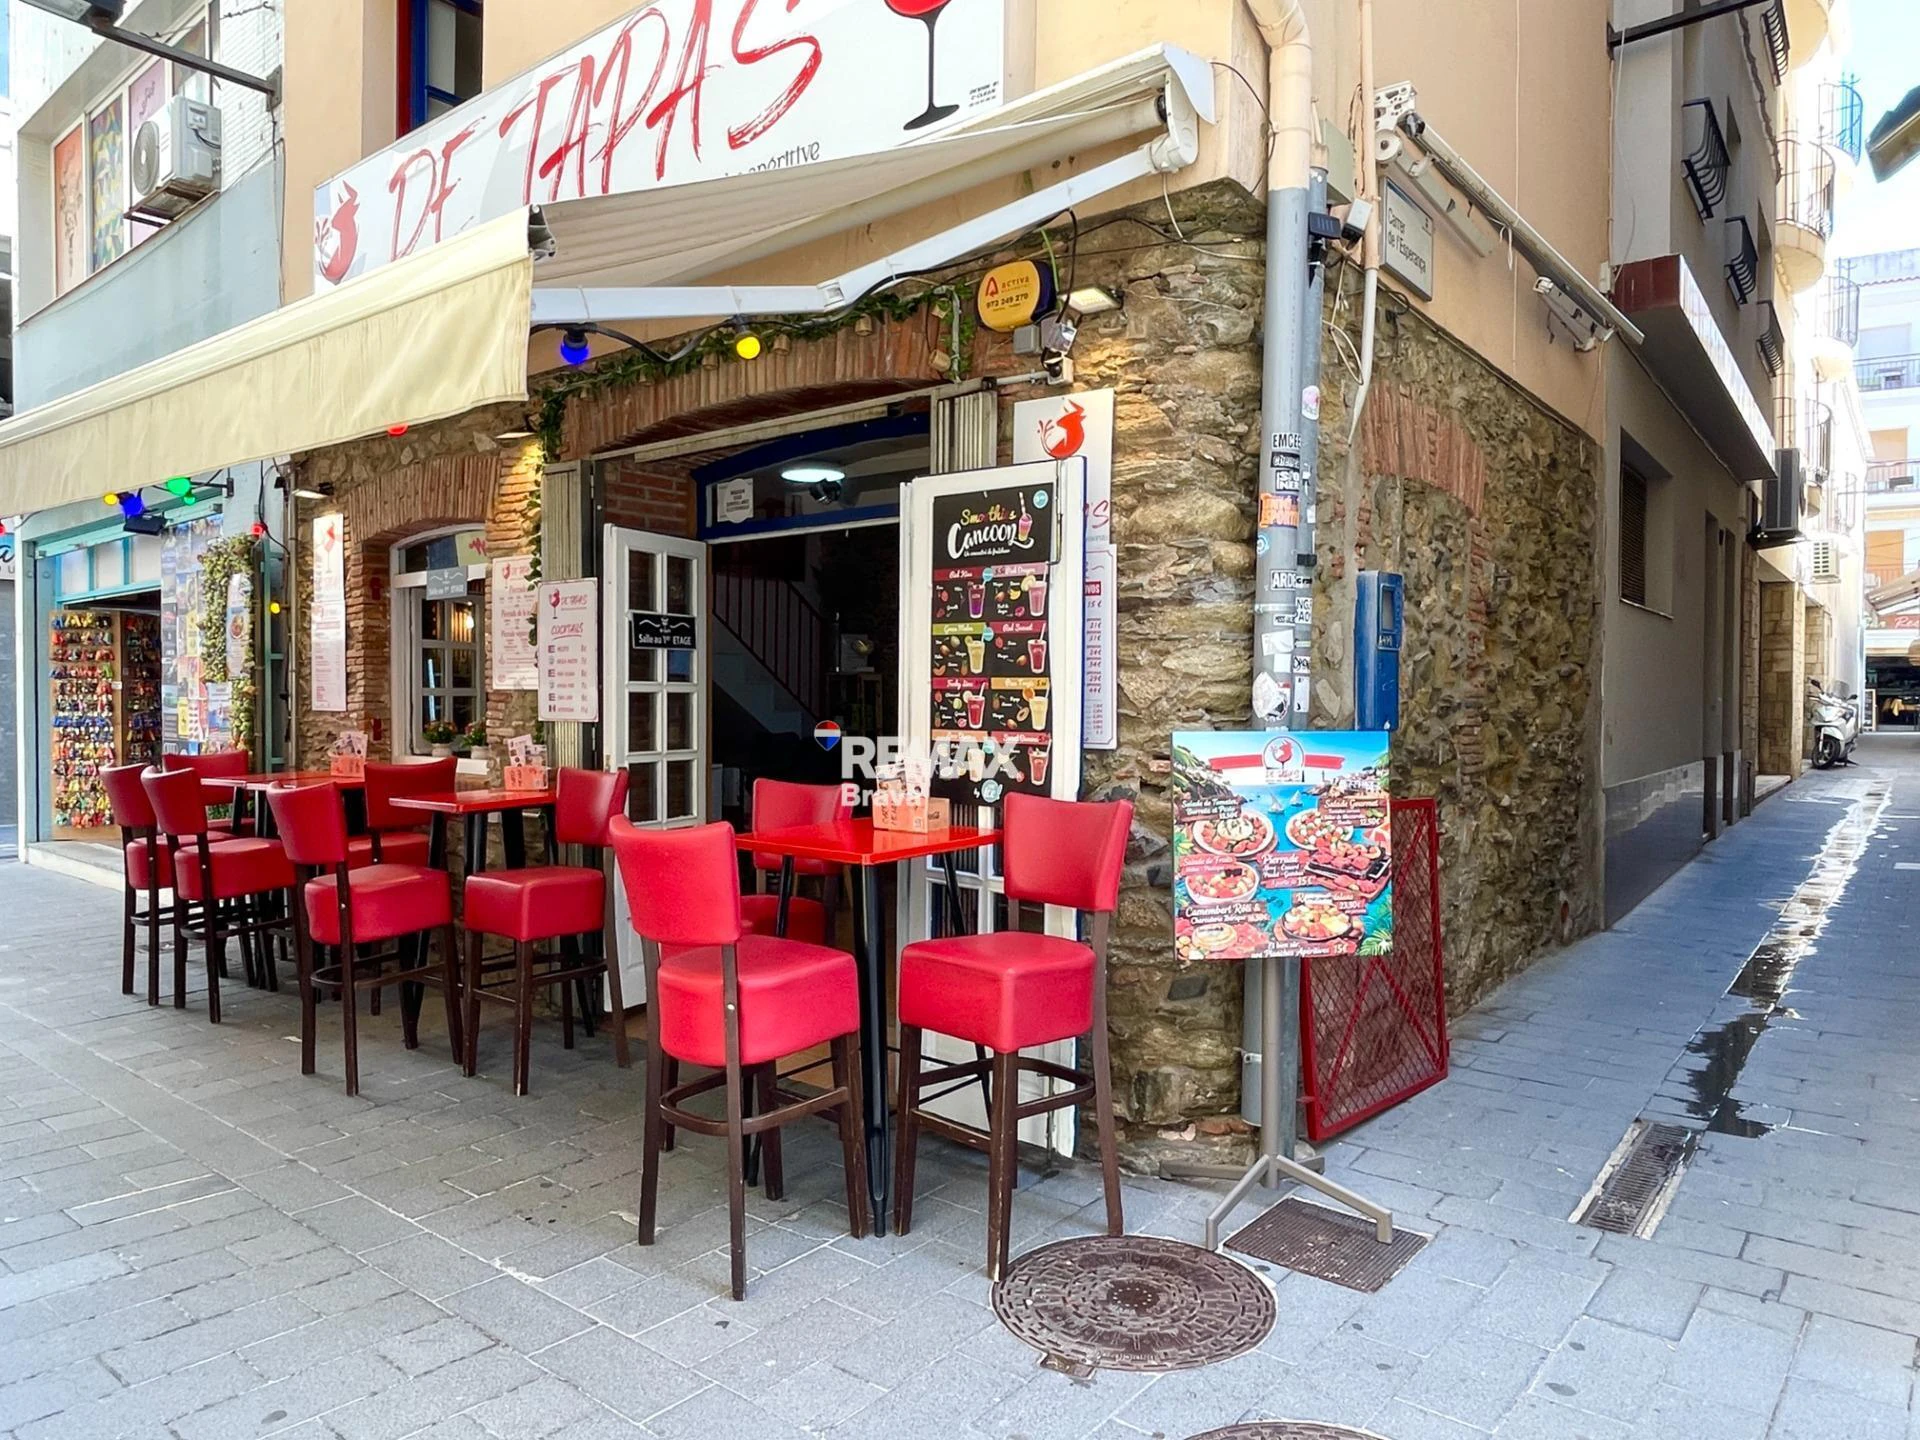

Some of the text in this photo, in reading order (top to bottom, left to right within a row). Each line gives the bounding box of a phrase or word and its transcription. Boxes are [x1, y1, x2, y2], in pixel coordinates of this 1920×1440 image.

[500, 0, 823, 206] TAPAS
[1001, 275, 1030, 290] ACTIVA
[1015, 292, 1030, 302] 270
[960, 504, 1017, 526] Smoothies
[947, 523, 1035, 559] Cancoon
[673, 636, 692, 646] ETAGE
[1182, 799, 1202, 808] Salade
[1325, 799, 1379, 809] Salade Gourmet
[1261, 854, 1299, 864] Pierrade
[1186, 905, 1232, 918] Camembert
